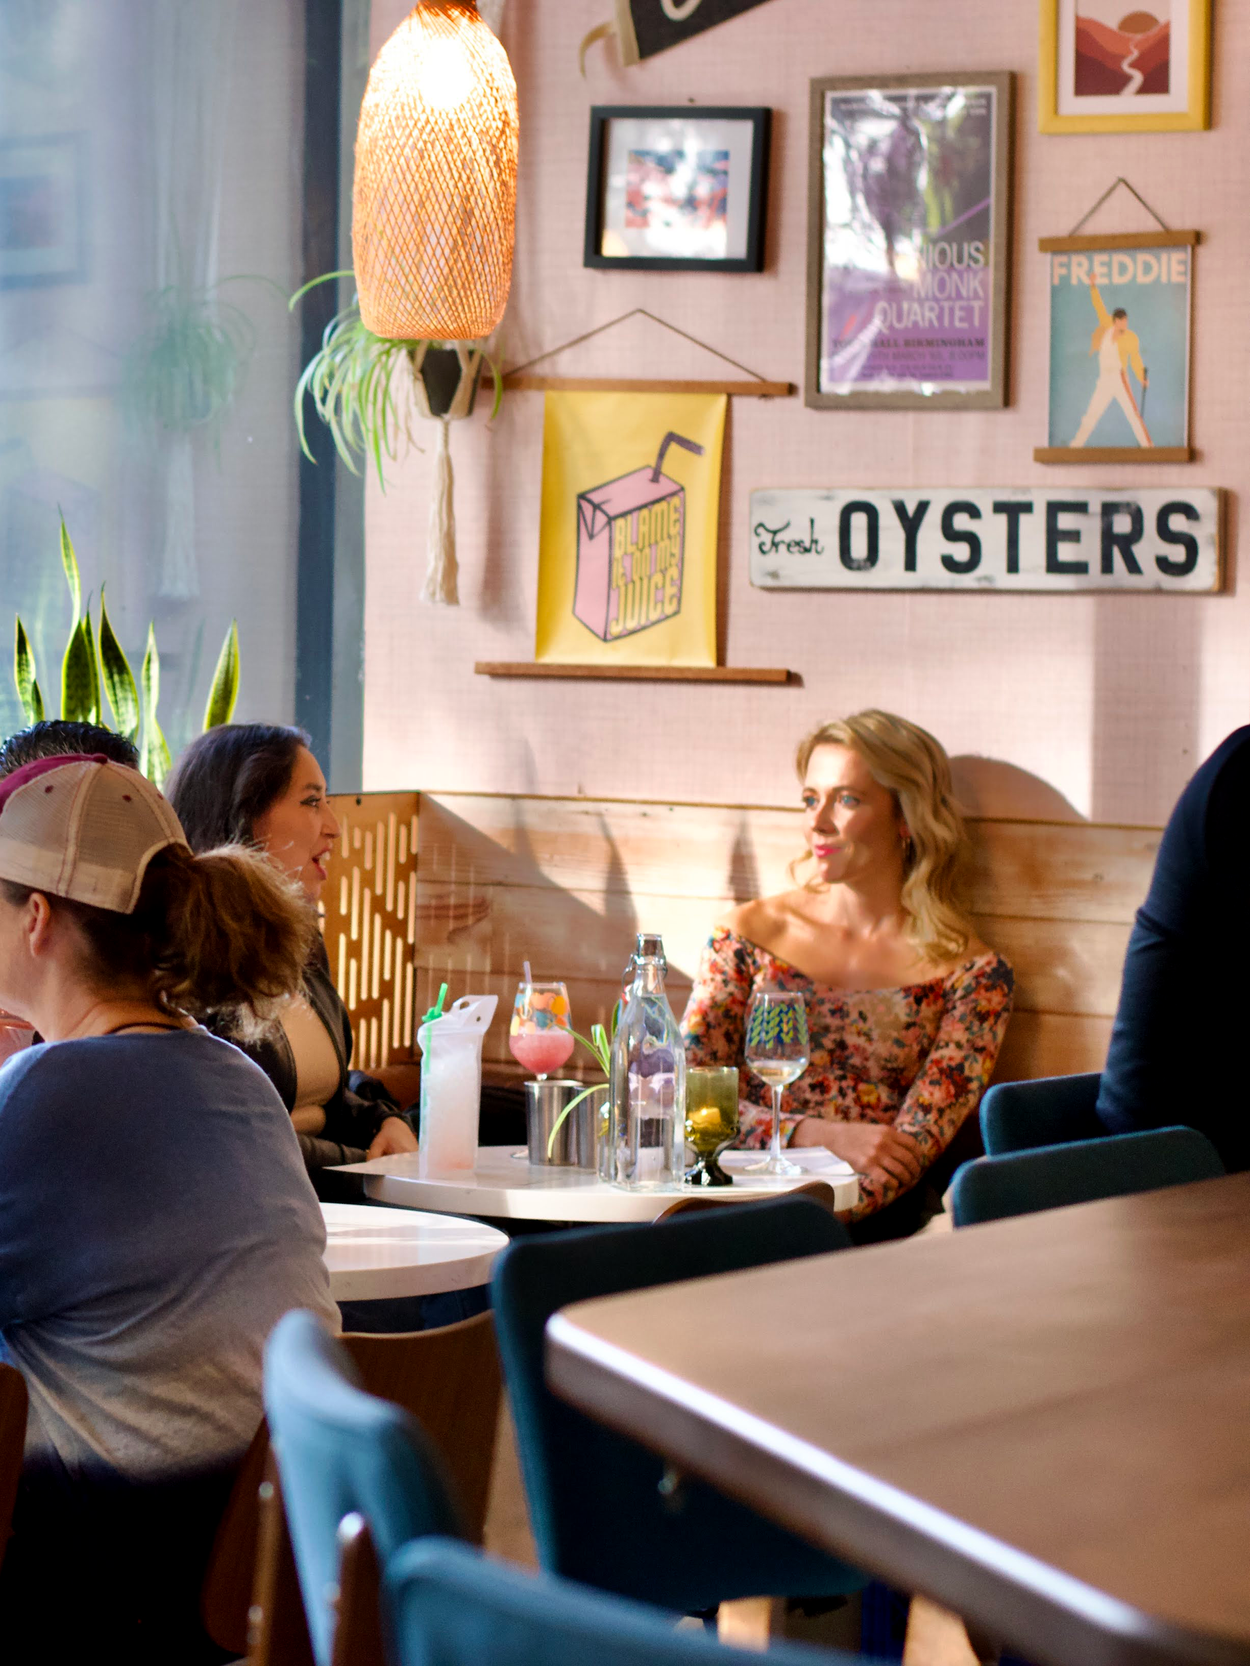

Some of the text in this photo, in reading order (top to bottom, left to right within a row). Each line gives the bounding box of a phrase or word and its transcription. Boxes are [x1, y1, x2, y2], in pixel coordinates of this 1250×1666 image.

[918, 241, 985, 270] NIOUS
[1052, 252, 1187, 286] FREDDIE
[913, 271, 985, 299] MONK
[874, 301, 985, 334] QUARTET
[903, 337, 986, 349] BIRMINGHAM
[754, 499, 1199, 577] Fresh OYSTERS
[610, 565, 680, 637] JUICE
